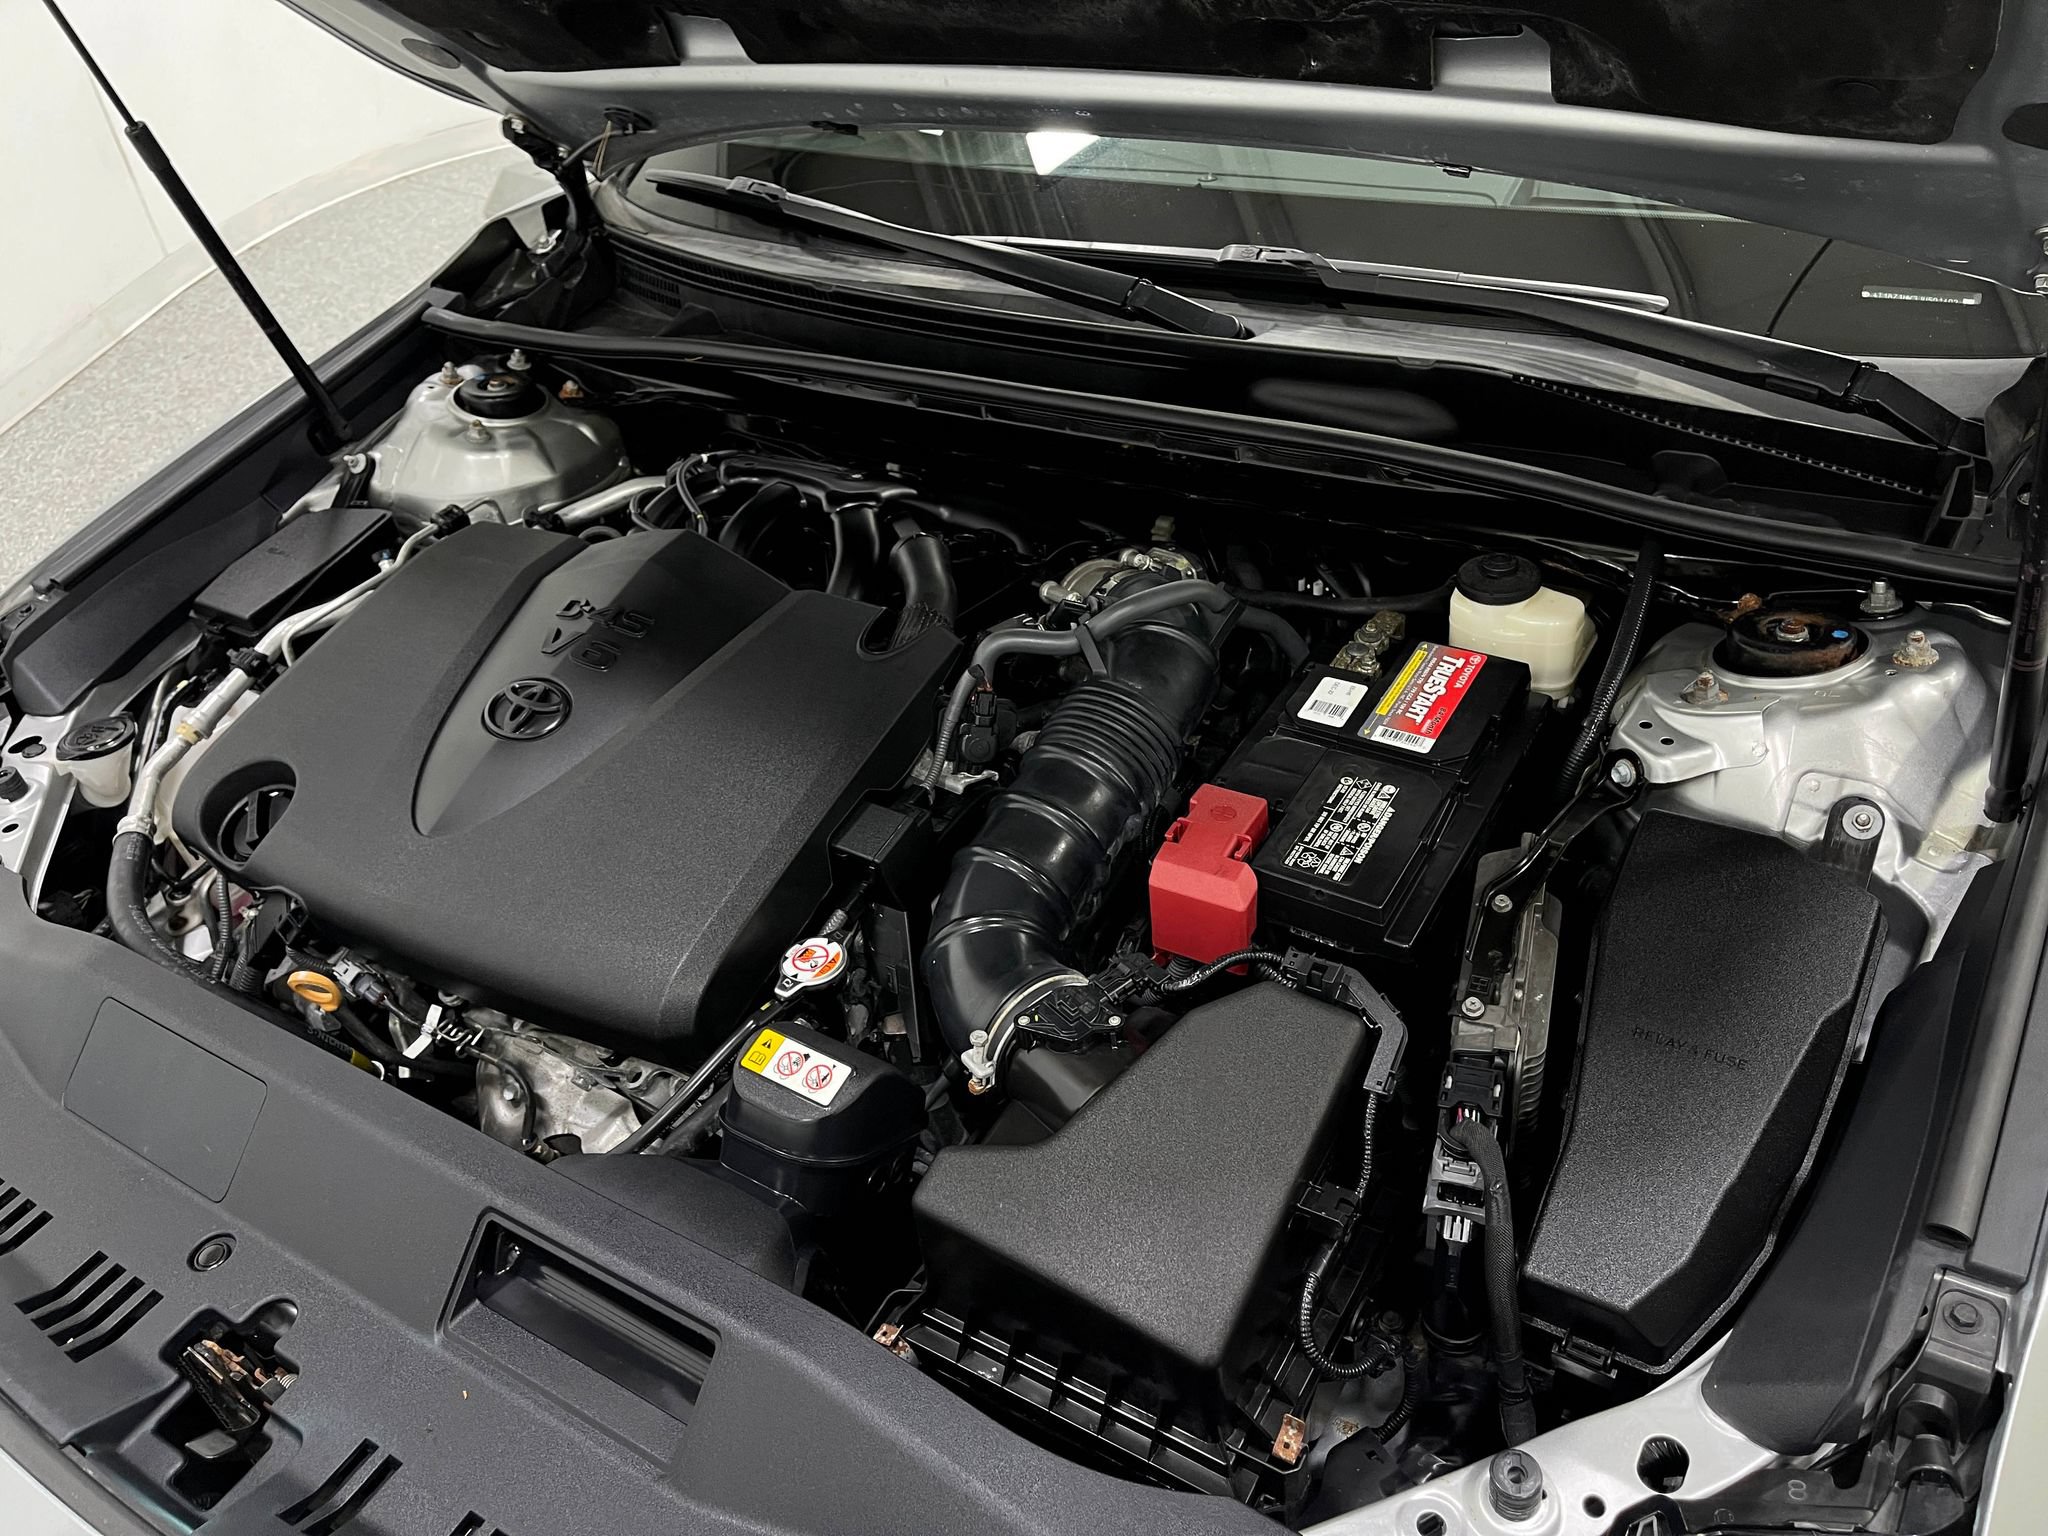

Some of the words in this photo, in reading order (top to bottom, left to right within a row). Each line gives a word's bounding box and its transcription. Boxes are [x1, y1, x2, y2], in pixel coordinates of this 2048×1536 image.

[541, 627, 623, 672] V6
[1454, 664, 1475, 688] TOYOTA
[1424, 716, 1443, 735] Month
[1633, 1026, 1687, 1050] RELAY
[1703, 1049, 1750, 1070] FUSE
